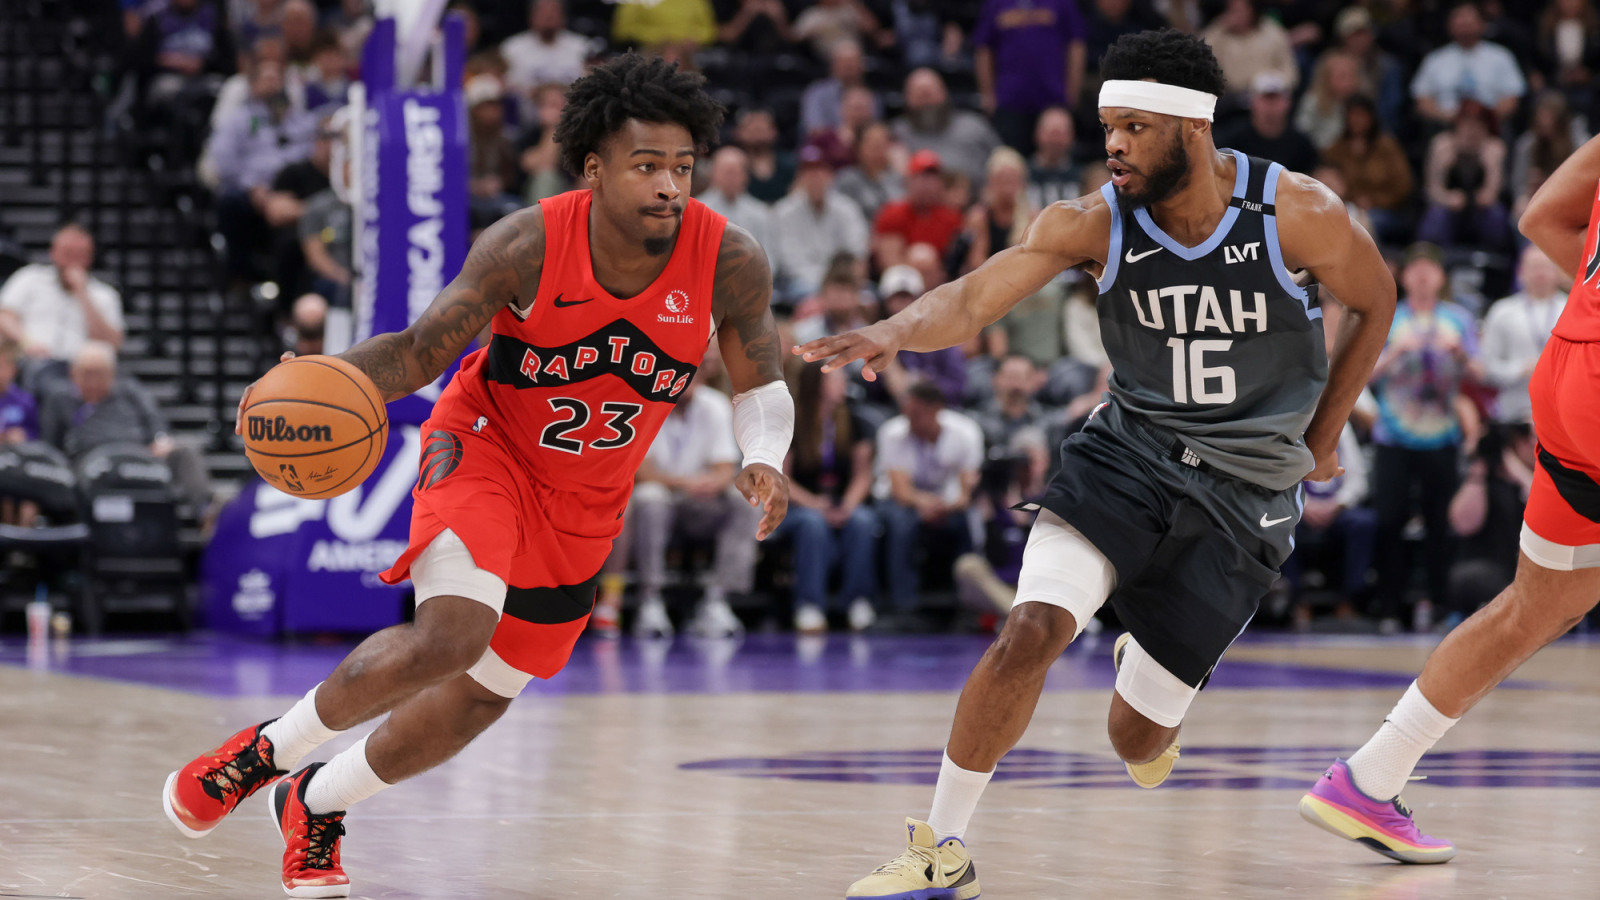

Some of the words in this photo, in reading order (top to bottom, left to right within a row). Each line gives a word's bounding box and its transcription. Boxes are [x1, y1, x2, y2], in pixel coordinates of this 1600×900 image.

[402, 98, 444, 217] FIRST
[1241, 200, 1263, 212] FRANK
[1223, 241, 1261, 265] LVT
[657, 313, 675, 323] Sun
[676, 314, 694, 324] Life
[1129, 284, 1268, 335] UTAH
[519, 335, 690, 397] RAPTORS
[1166, 337, 1237, 404] 16
[247, 415, 333, 442] Wilson
[538, 396, 644, 456] 23
